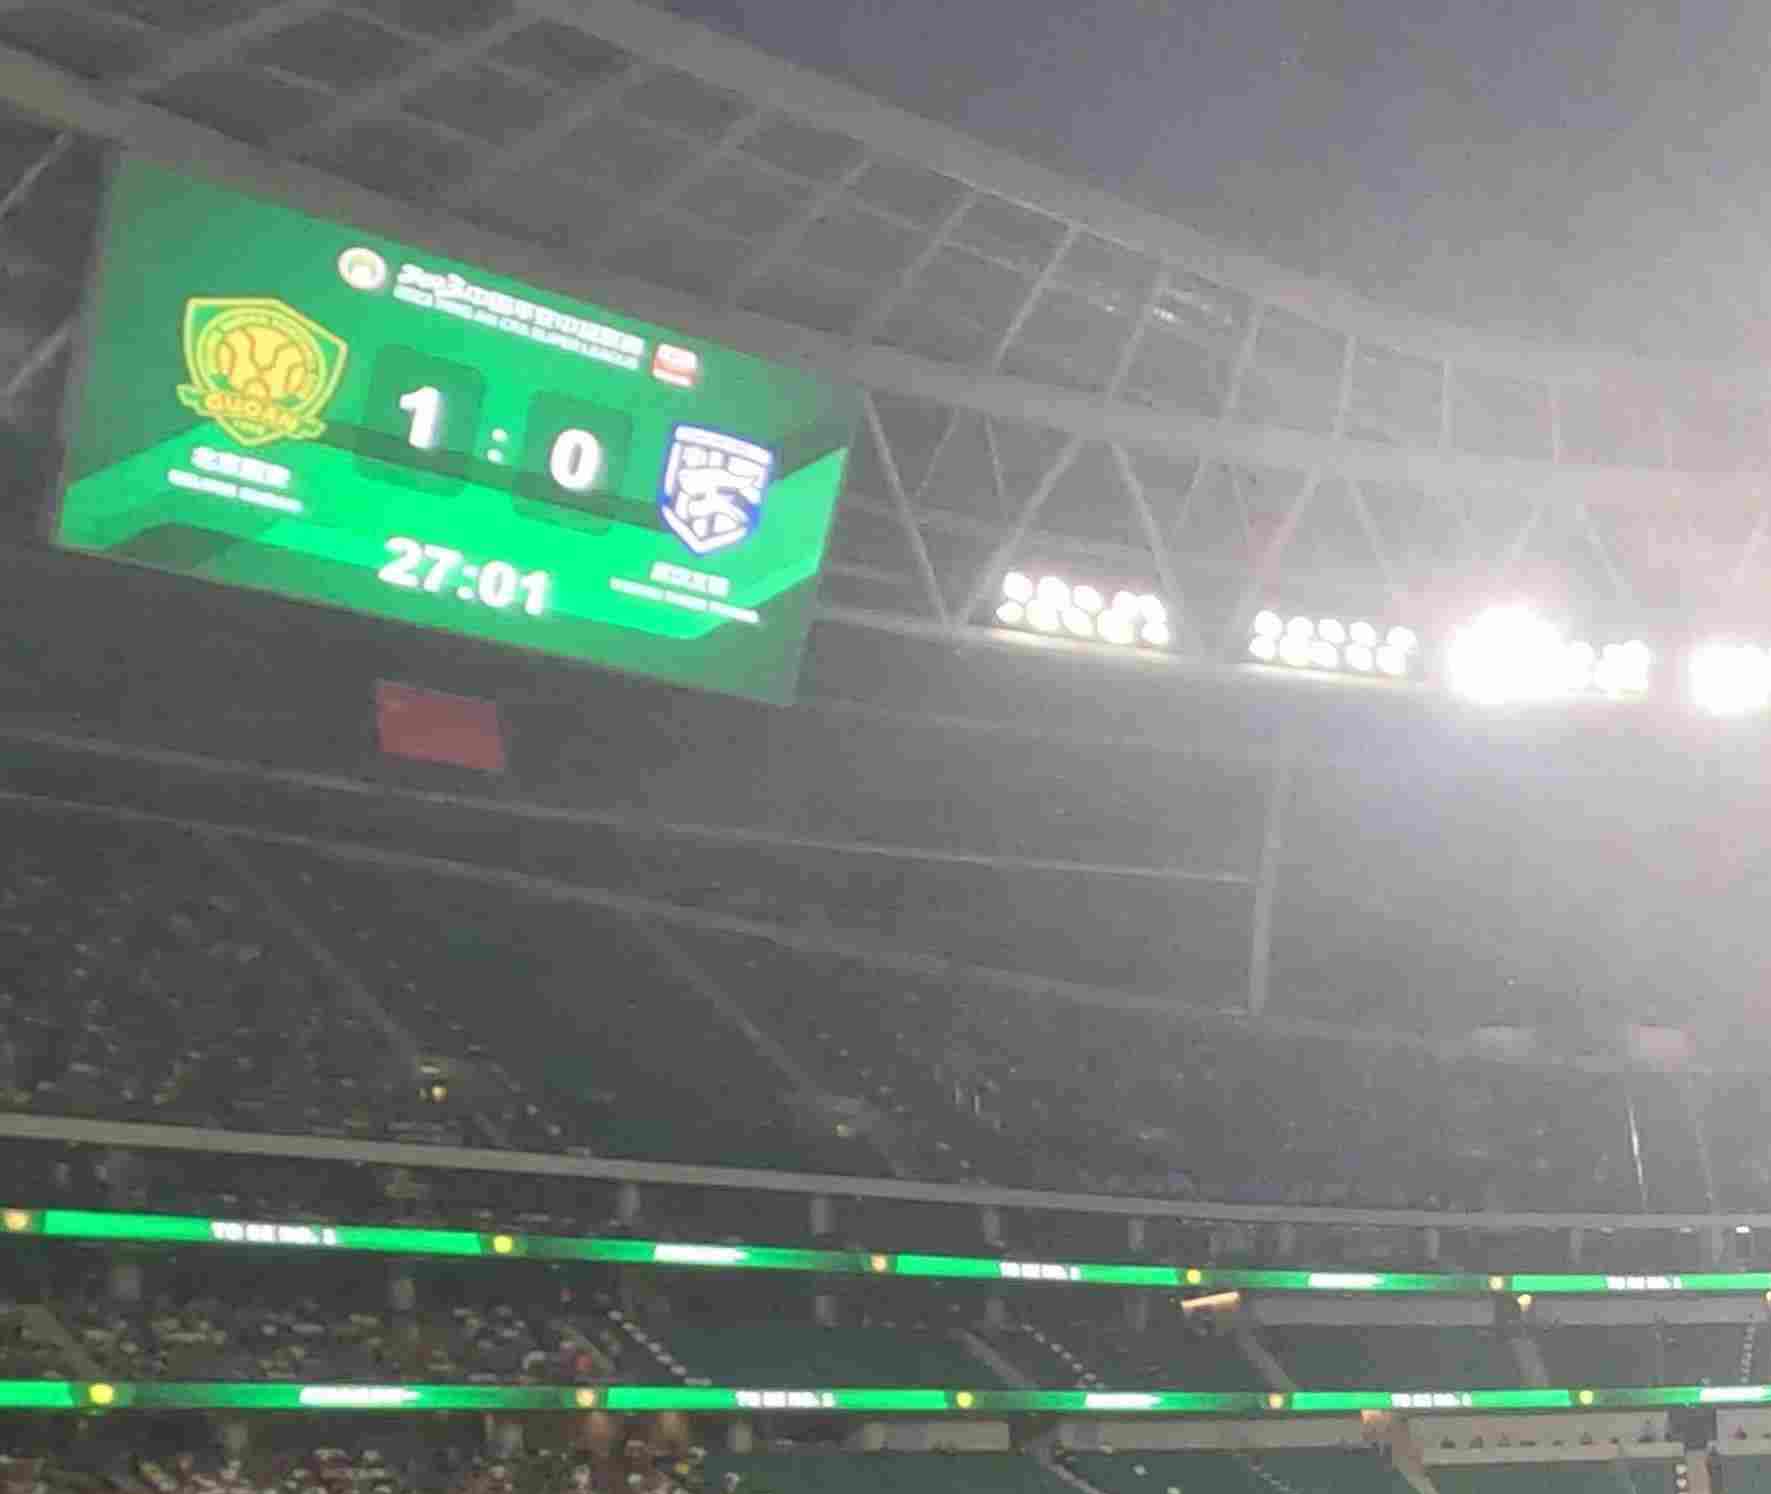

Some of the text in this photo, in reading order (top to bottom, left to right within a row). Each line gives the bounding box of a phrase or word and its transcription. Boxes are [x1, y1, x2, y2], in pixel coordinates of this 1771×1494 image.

[400, 385, 441, 449] 1
[550, 428, 600, 491] 0
[377, 536, 554, 616] 27:01
